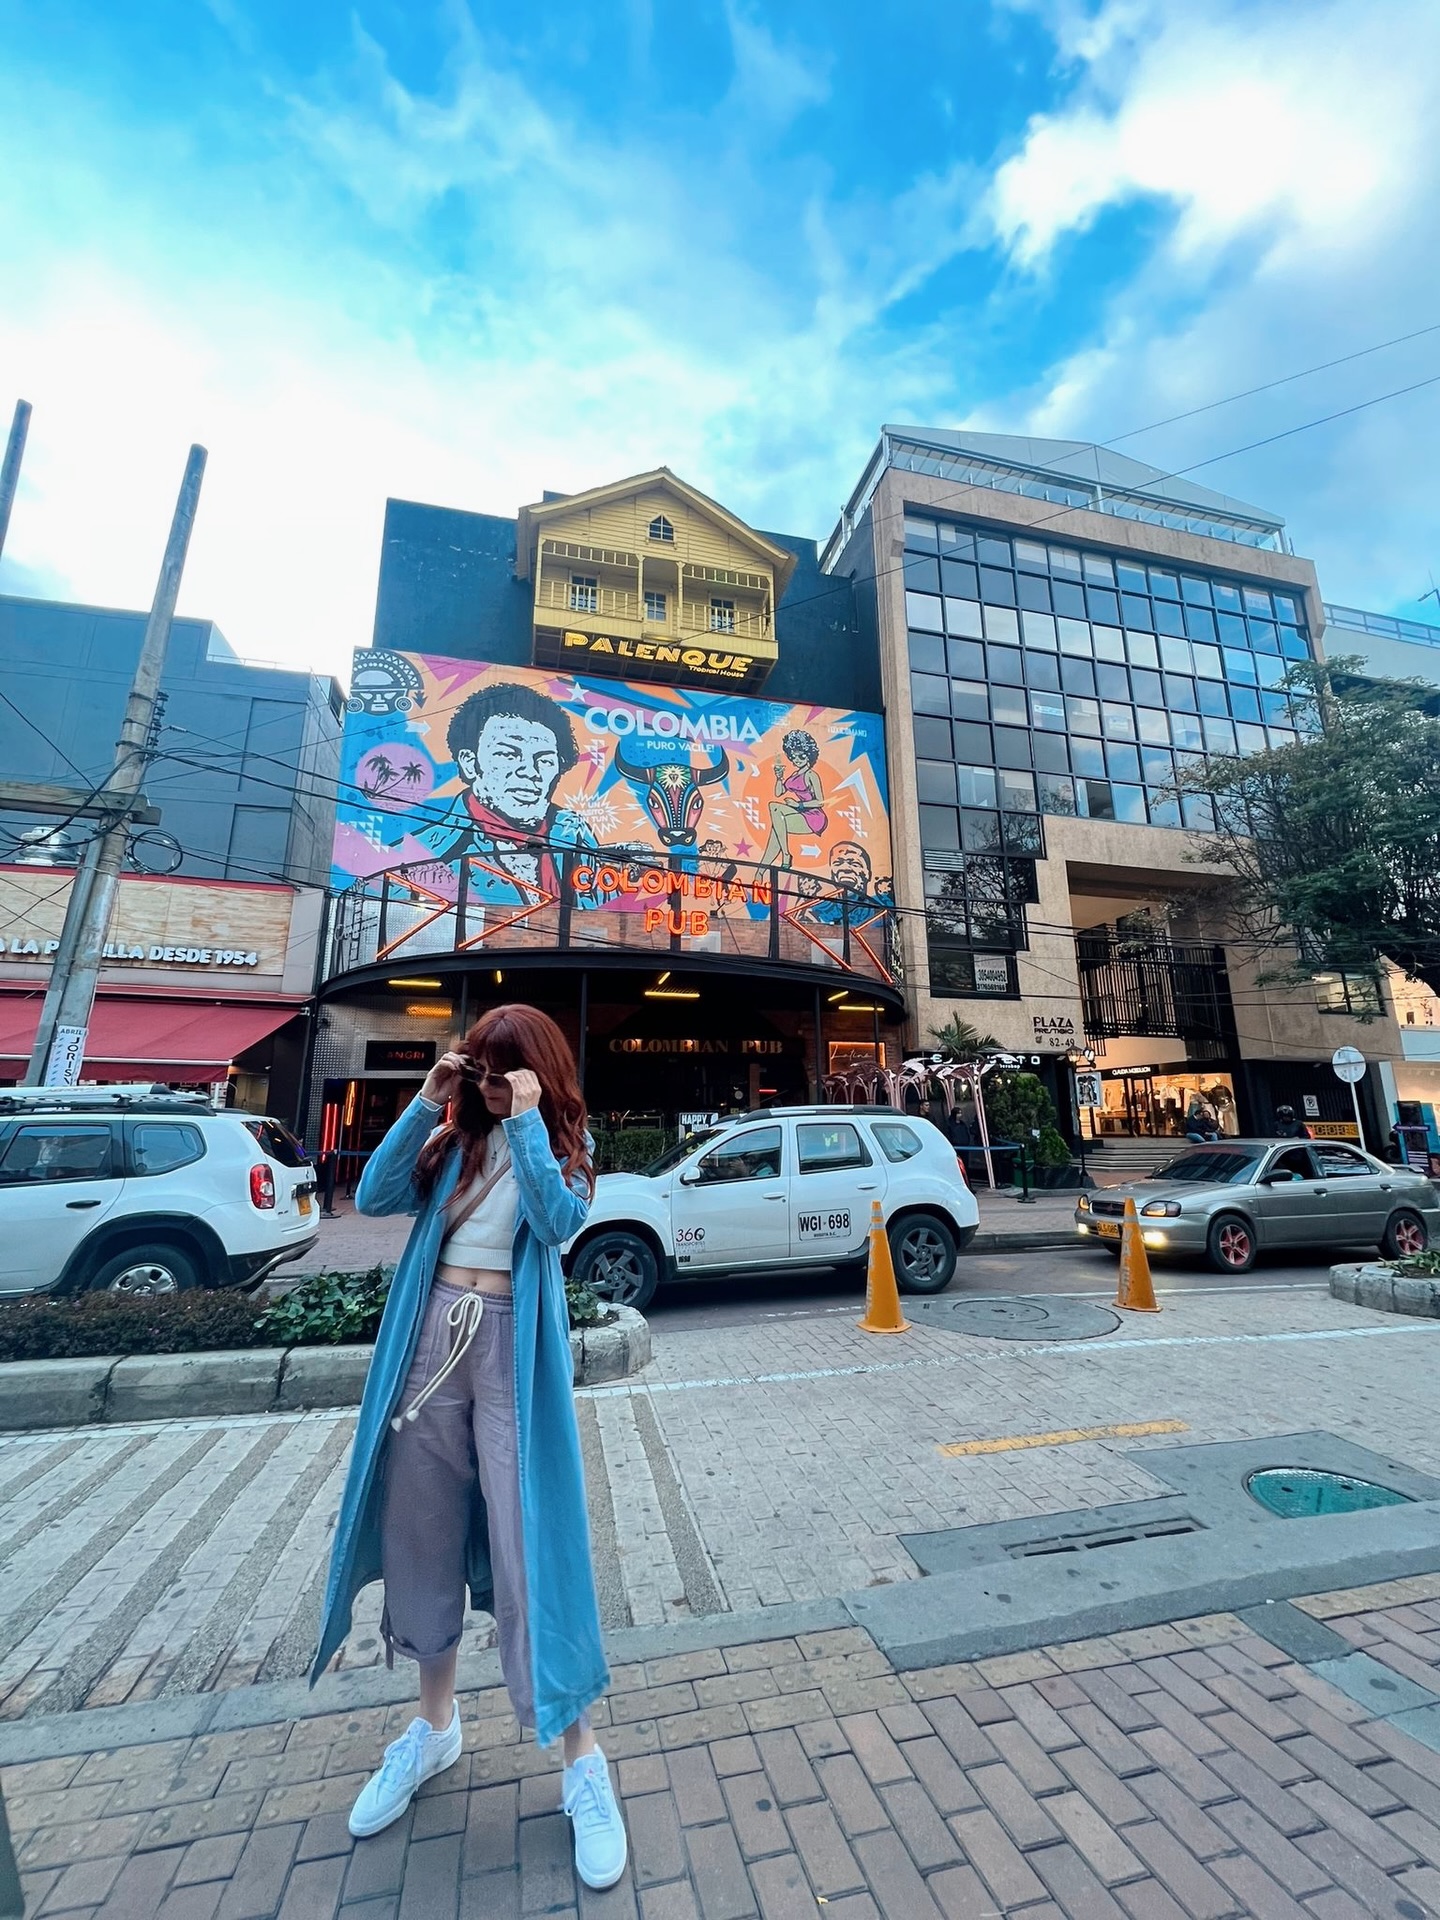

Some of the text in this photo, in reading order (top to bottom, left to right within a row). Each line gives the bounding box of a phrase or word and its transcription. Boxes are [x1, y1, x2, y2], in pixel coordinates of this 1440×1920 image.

[564, 631, 753, 672] PALENQUE
[688, 665, 745, 678] Tropical House
[584, 706, 762, 743] COLOMBIA
[646, 739, 677, 751] PURO
[678, 741, 715, 754] VACILE!
[587, 801, 602, 809] UN
[571, 865, 773, 905] COLOMBIAN
[644, 907, 710, 937] PUB
[10, 938, 39, 955] LA
[149, 945, 213, 965] DESDE
[214, 948, 258, 967] 1954
[1033, 1016, 1075, 1028] PLAZA
[60, 1028, 83, 1036] ABRIL
[609, 1038, 783, 1054] COLOMBIAN PUB
[681, 1114, 708, 1125] HAPPY
[799, 1213, 850, 1232] WGI 698
[675, 1226, 706, 1243] 360
